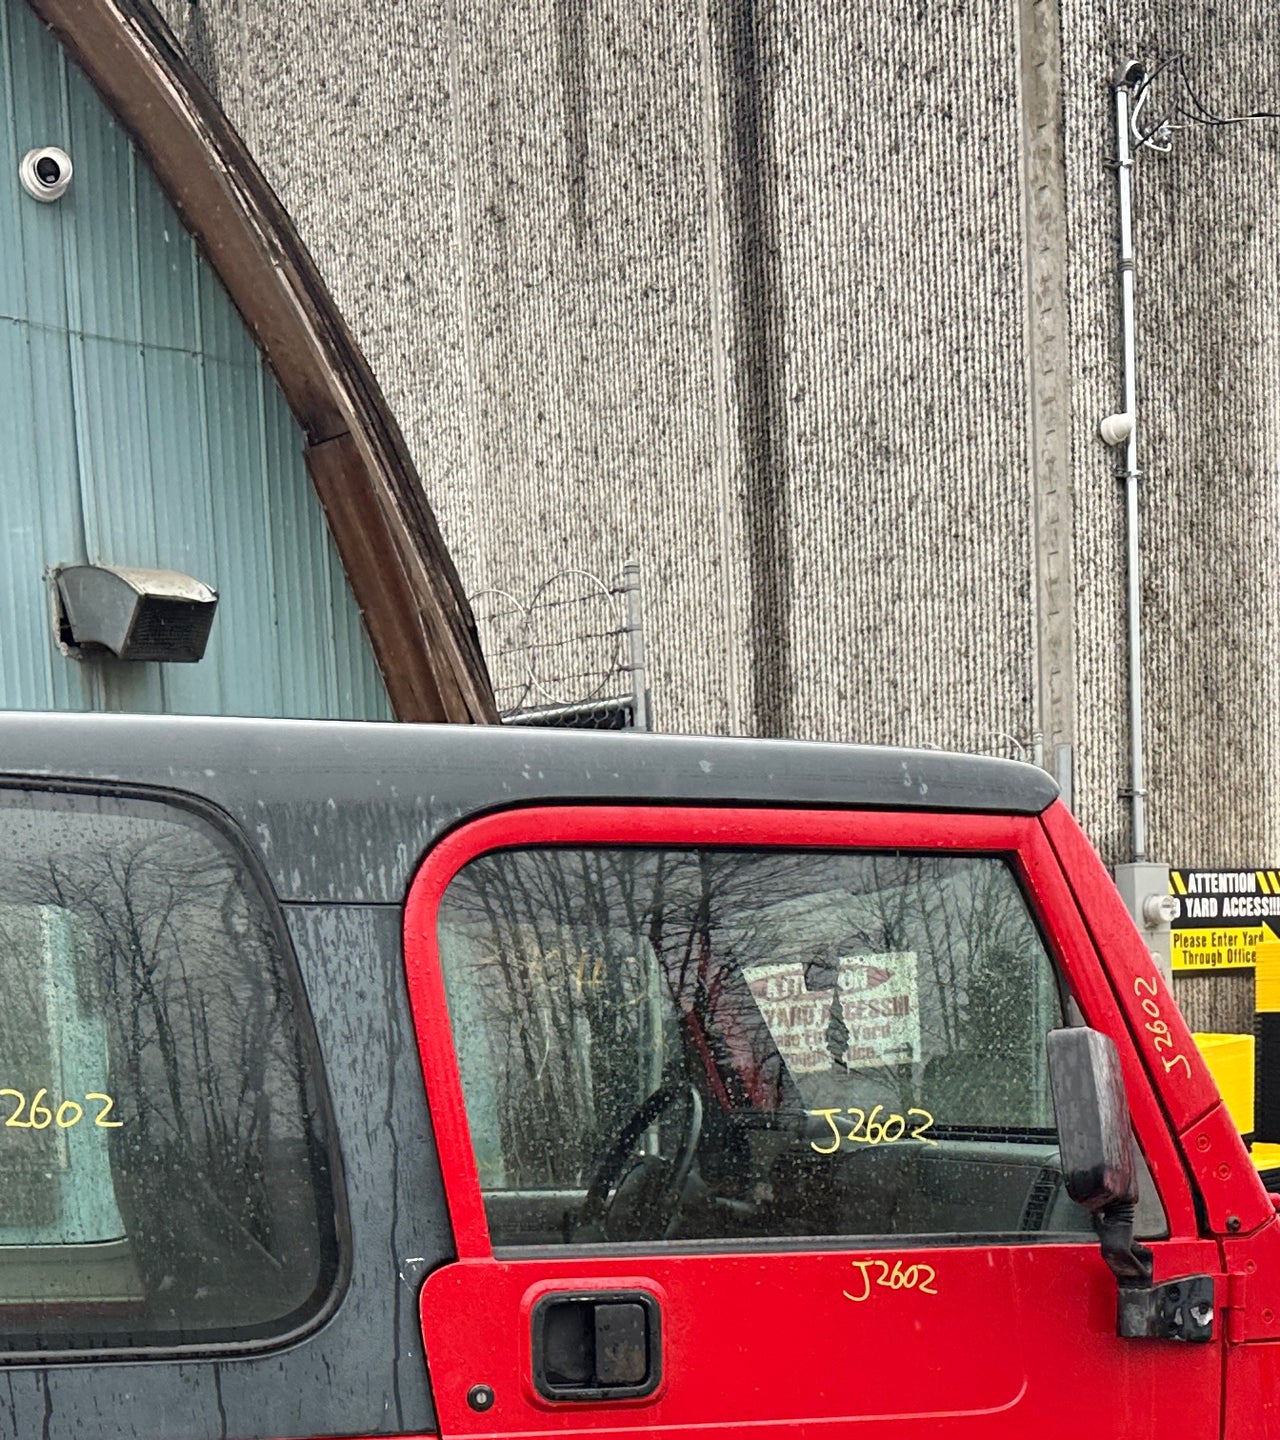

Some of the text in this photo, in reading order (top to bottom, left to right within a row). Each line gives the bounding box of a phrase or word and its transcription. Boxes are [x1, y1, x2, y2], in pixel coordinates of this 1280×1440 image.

[1188, 872, 1256, 893] ATTENTION
[1185, 897, 1218, 918] YARD
[1223, 896, 1280, 917] ACCESS!!!
[1173, 931, 1264, 949] Please Enter Yard
[1182, 948, 1256, 967] Through Office
[1134, 976, 1192, 1079] J2602
[810, 1105, 938, 1154] J2602
[843, 1260, 938, 1302] J2602
